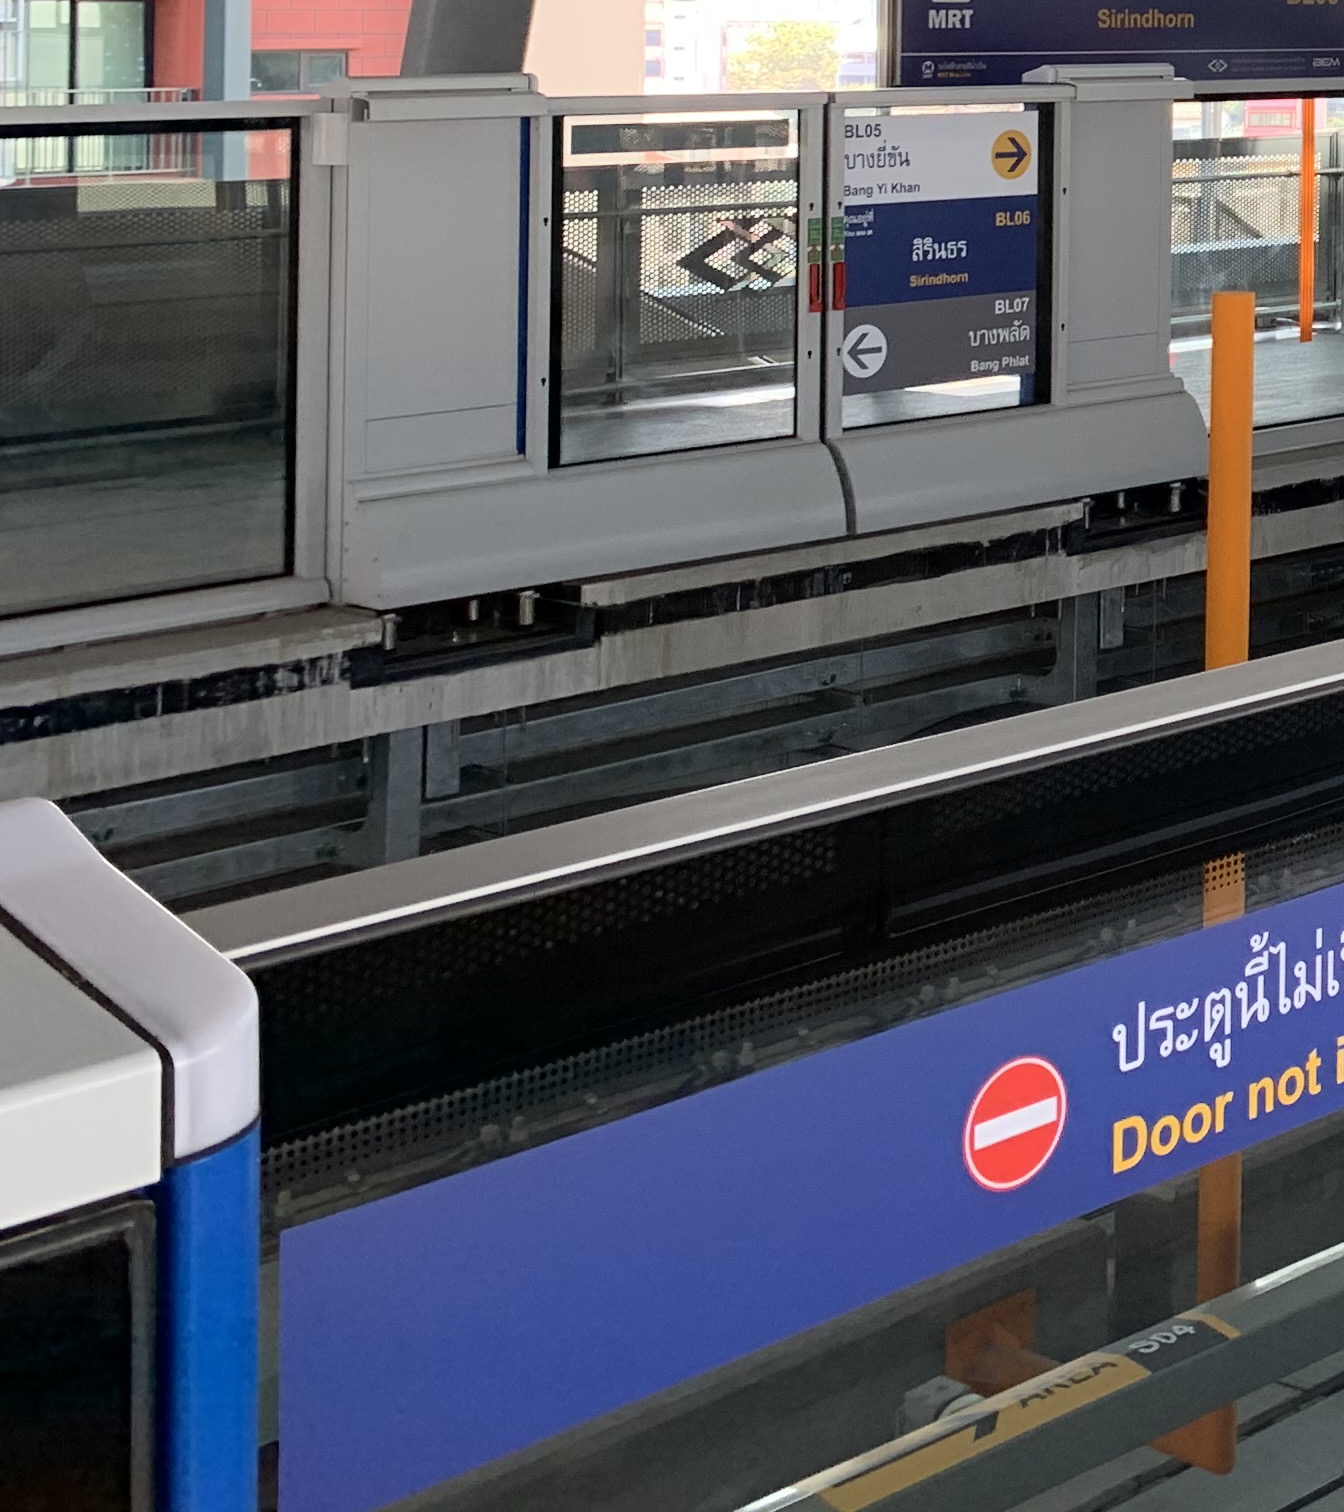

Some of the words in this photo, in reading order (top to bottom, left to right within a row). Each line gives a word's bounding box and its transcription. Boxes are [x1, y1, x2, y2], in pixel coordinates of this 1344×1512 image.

[928, 9, 973, 29] MRT
[1097, 8, 1195, 29] Sirindhorn
[844, 124, 882, 138] BL05
[844, 140, 911, 169] บางยี่ขัน
[843, 184, 874, 198] Bang
[876, 183, 888, 194] Yi
[890, 182, 920, 194] Khan
[995, 210, 1031, 226] BL06
[911, 237, 967, 262] สิรินธร
[909, 271, 969, 287] Sirindhorn
[994, 297, 1030, 314] BL07
[968, 320, 1030, 347] บางพลัด
[970, 359, 999, 372] Bang
[1002, 354, 1030, 367] Phlat
[1112, 1090, 1233, 1175] Door
[1248, 1048, 1322, 1120] not
